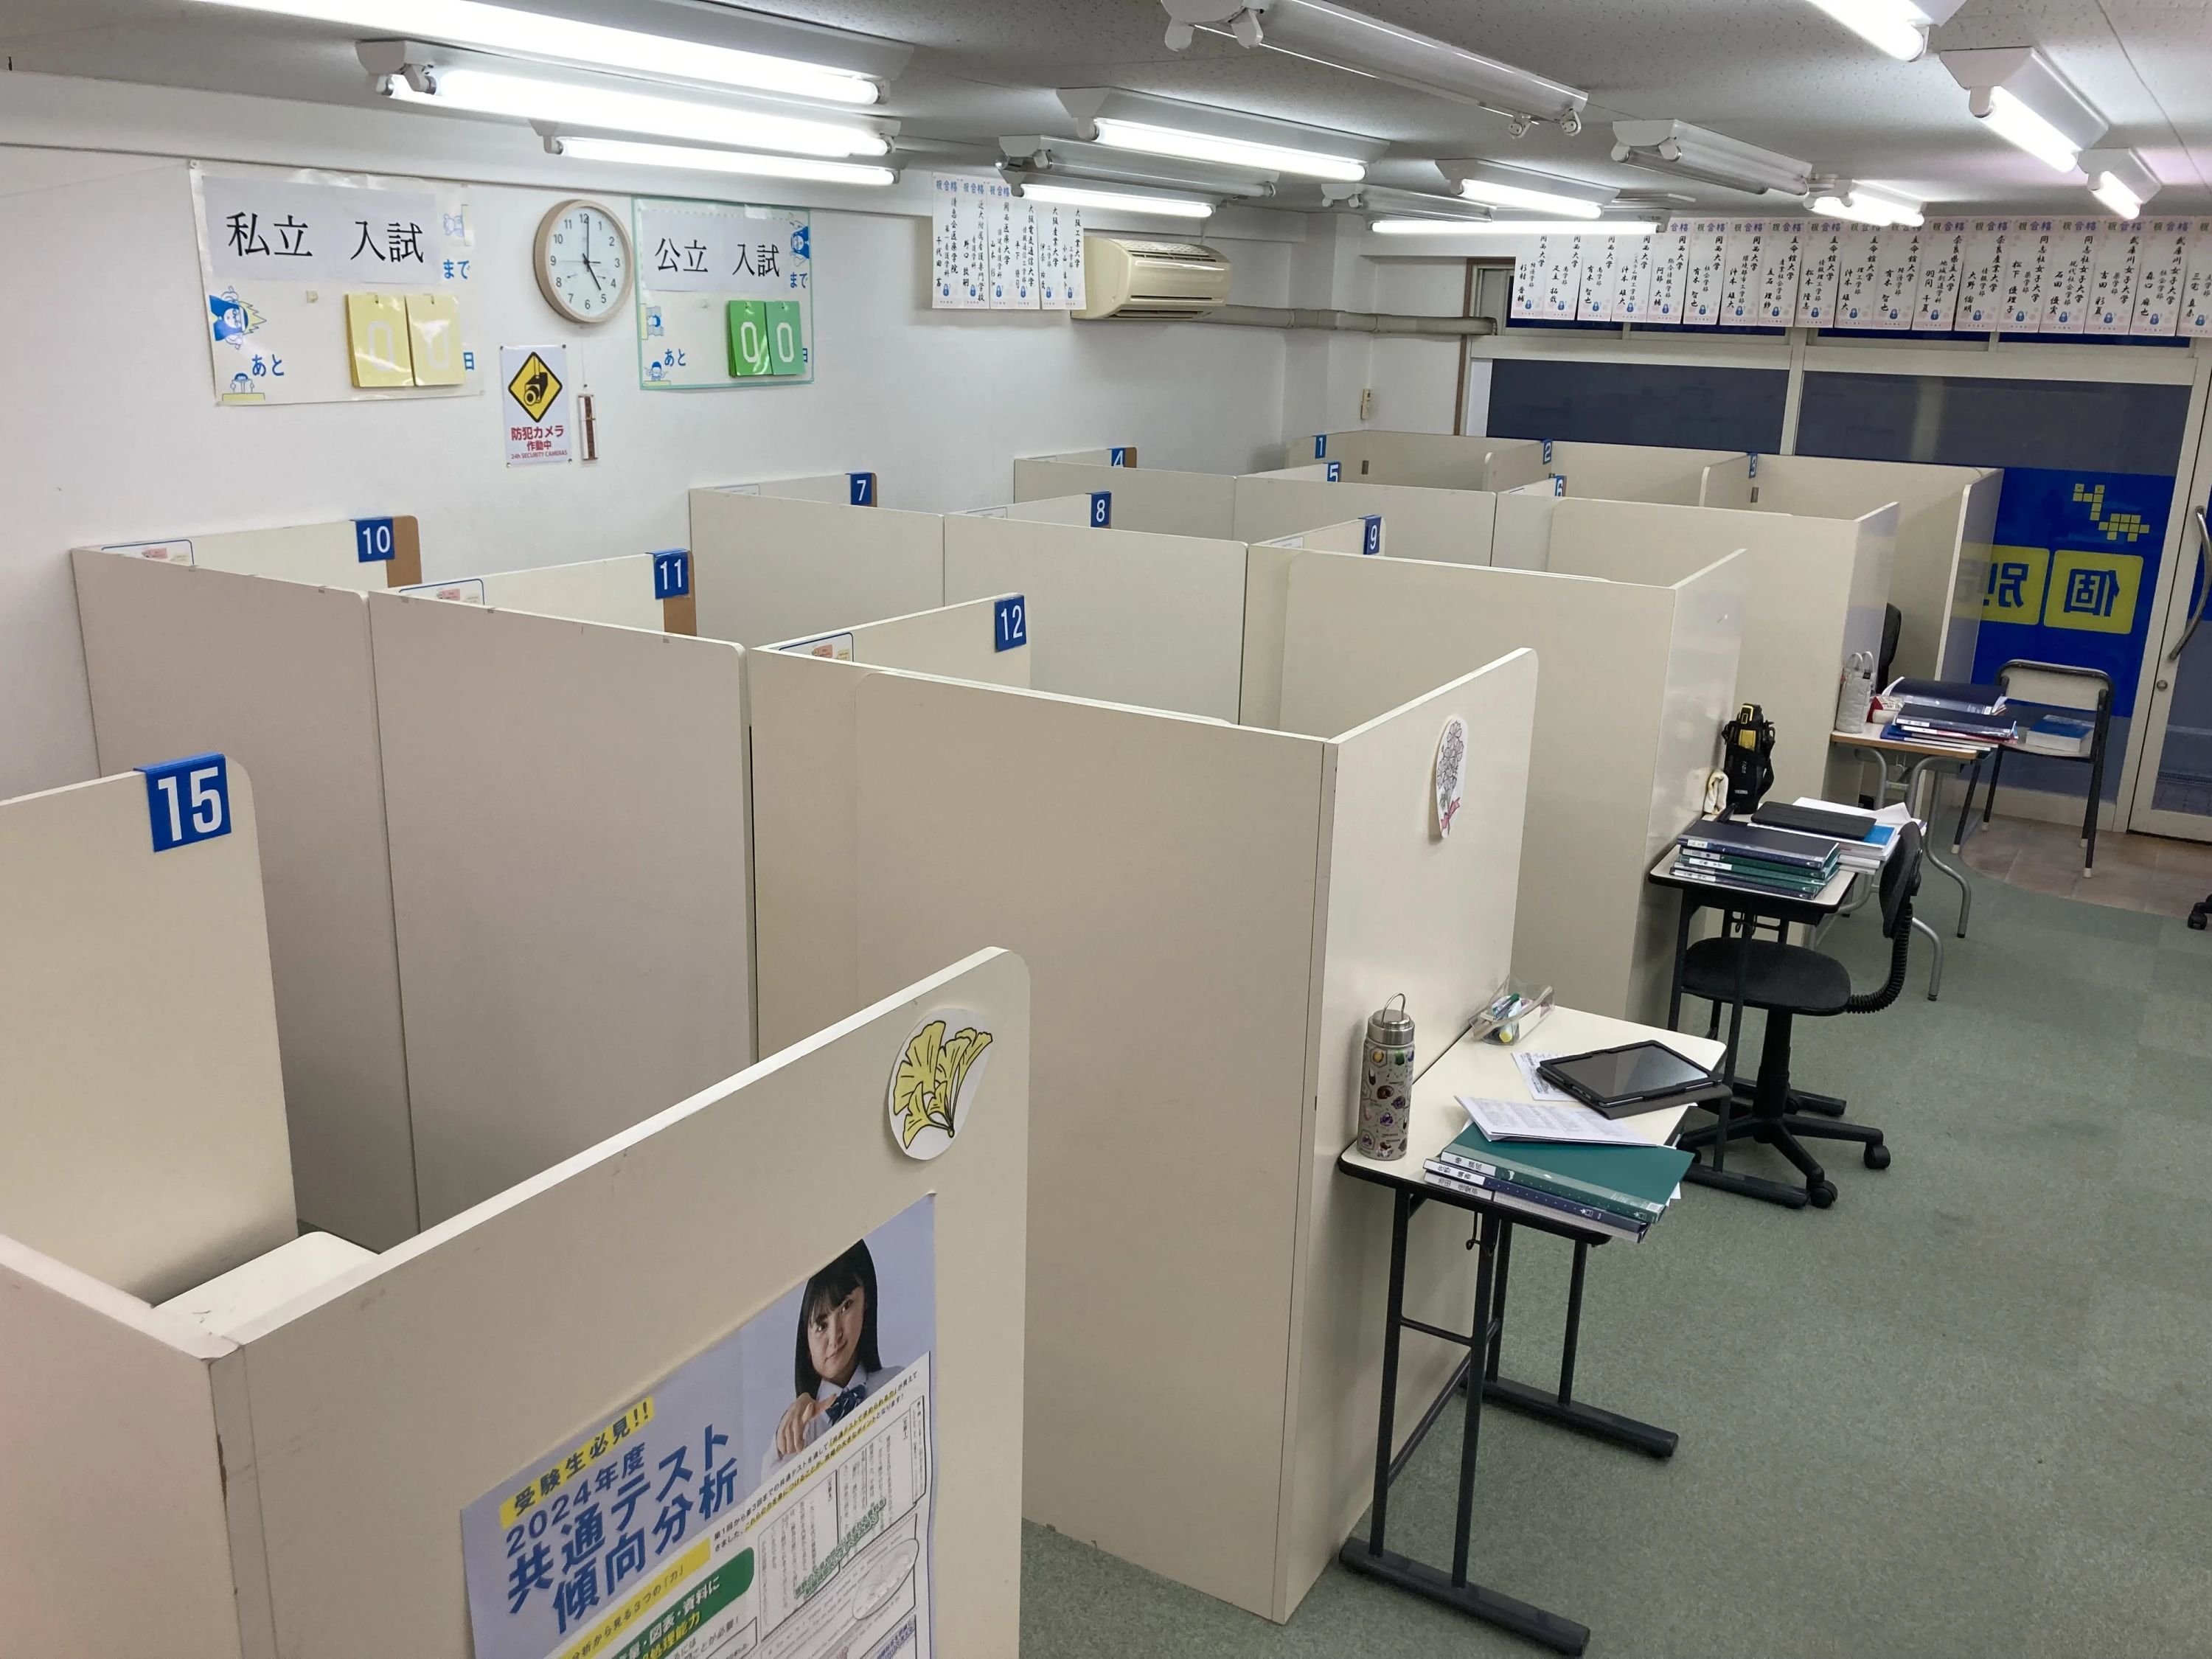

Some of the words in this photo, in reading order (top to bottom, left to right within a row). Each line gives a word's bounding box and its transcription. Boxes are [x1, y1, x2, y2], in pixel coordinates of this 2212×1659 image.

[564, 219, 572, 229] 11
[580, 213, 589, 223] 12
[598, 221, 602, 231] 1
[1933, 222, 1964, 231] 祝合格
[1976, 221, 2008, 231] 祝合格
[2019, 220, 2052, 231] 祝合格
[2063, 221, 2096, 231] 祝合格
[1697, 223, 1725, 232] 祝合格
[1734, 223, 1763, 232] 祝合格
[1773, 223, 1801, 232] 祝合格
[1811, 223, 1840, 232] 祝合格
[226, 212, 313, 257] 私立
[349, 221, 423, 263] 入試
[553, 234, 563, 244] 10
[608, 236, 615, 246] 2
[550, 255, 556, 265] 9
[655, 237, 709, 273] 公立
[732, 243, 780, 277] 入試
[1676, 235, 1686, 270] 関西大学
[1713, 235, 1723, 271] 関西大学
[1750, 236, 1761, 271] 関西大学
[1787, 236, 1798, 281] 立命館大学
[1826, 236, 1838, 282] 立命館大学
[1865, 236, 1878, 282] 立命館大学
[1906, 236, 1919, 282] 立命館大学
[443, 260, 470, 279] まで
[615, 258, 620, 268] 3
[2031, 235, 2048, 302] 同志社女子大学
[2075, 235, 2093, 303] 同志社女子大学
[556, 277, 562, 288] 8
[611, 278, 616, 288] 4
[790, 272, 808, 288] まで
[568, 293, 574, 303] 7
[585, 299, 591, 309] 6
[601, 293, 606, 303] 5
[252, 355, 285, 377] あと
[463, 352, 475, 370] 日
[664, 348, 686, 366] あと
[511, 425, 563, 441] 防犯カメラ
[526, 440, 552, 451] 作動中
[545, 449, 568, 457] CAMERAS
[1319, 437, 1324, 456] 1
[1544, 442, 1551, 462] 2
[1329, 464, 1338, 482] 5
[1750, 455, 1757, 476] 3
[855, 480, 866, 501] 7
[1095, 499, 1105, 523] 8
[362, 525, 392, 557] 10
[1370, 525, 1378, 551] 9
[659, 559, 684, 591] 11
[1001, 605, 1023, 641] 12
[157, 765, 223, 841] 15
[507, 1441, 646, 1558] 2024年度
[507, 1423, 729, 1615] 共通テスト
[552, 1457, 738, 1635] 傾向分析
